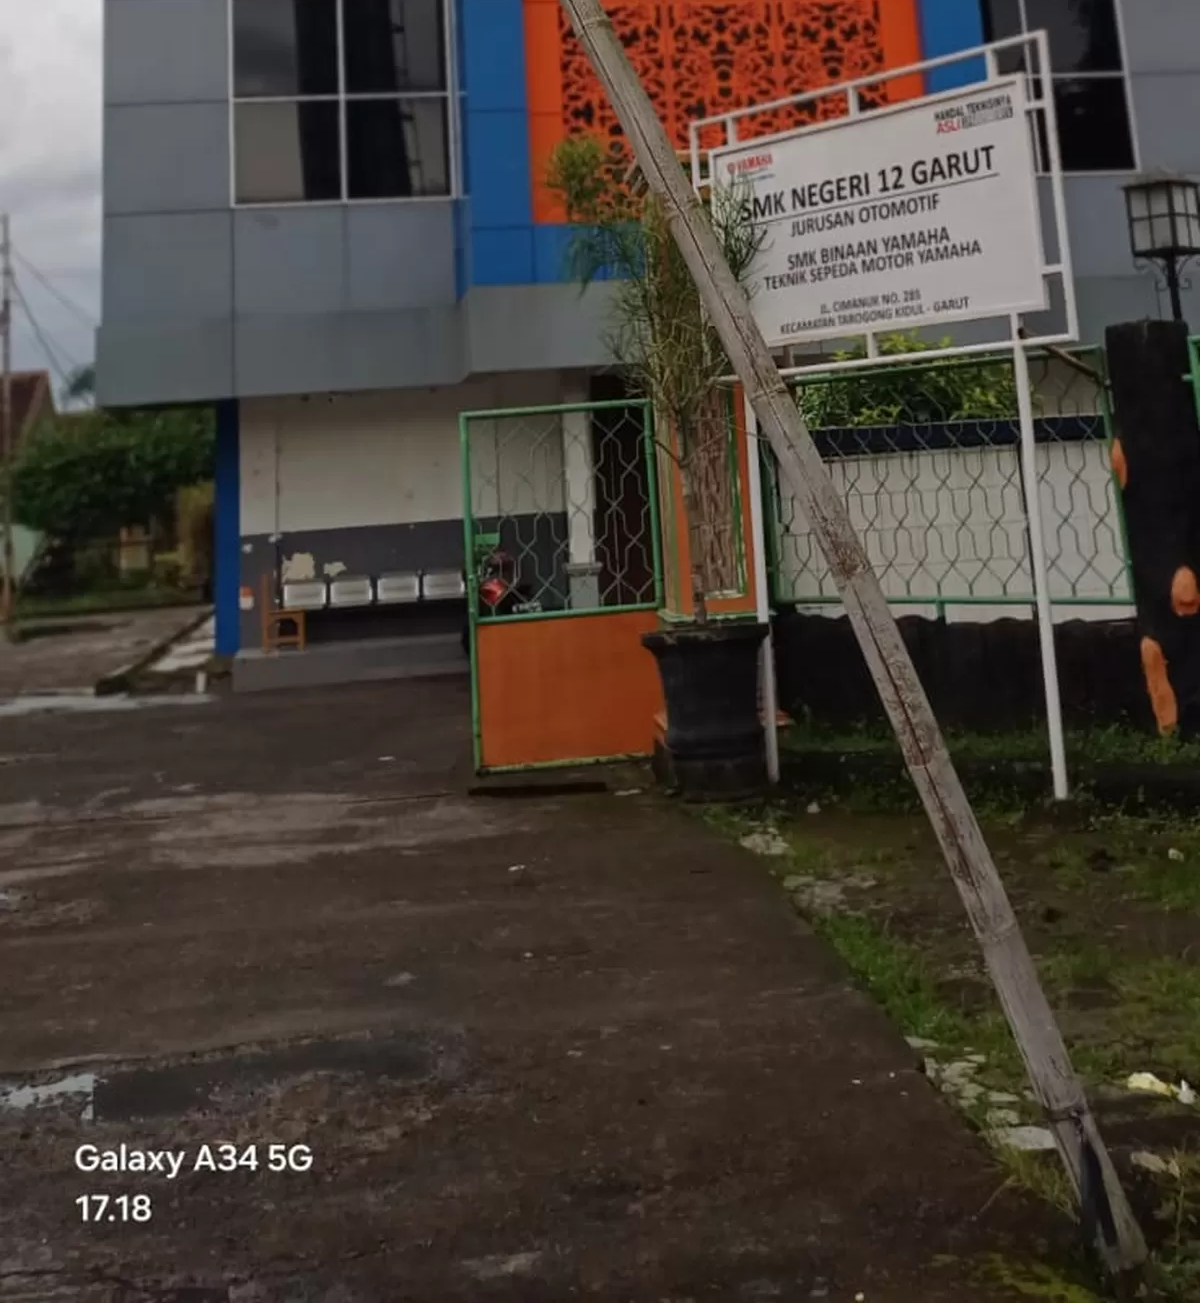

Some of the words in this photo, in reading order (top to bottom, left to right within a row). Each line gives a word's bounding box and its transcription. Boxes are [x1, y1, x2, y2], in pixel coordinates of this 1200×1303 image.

[741, 190, 786, 221] SMK
[791, 172, 870, 210] NEGERI
[878, 166, 905, 193] 12
[911, 145, 995, 185] GARUT
[790, 211, 855, 237] JURUSAN
[859, 193, 940, 224] OTOMOTIF
[764, 268, 808, 291] TEKNIK
[810, 260, 858, 283] SEPEDA
[861, 251, 914, 274] MOTOR
[917, 239, 983, 265] YAMAHA
[787, 249, 817, 271] SMK
[821, 238, 878, 264] BINAAN
[881, 226, 950, 252] YAMAHA
[780, 317, 836, 334] KECAMATAN
[837, 308, 893, 326] TAROGONG
[895, 302, 926, 319] KIDUL
[932, 296, 970, 314] GARUT
[833, 295, 879, 312] CIMANUK
[881, 291, 900, 307] NO.
